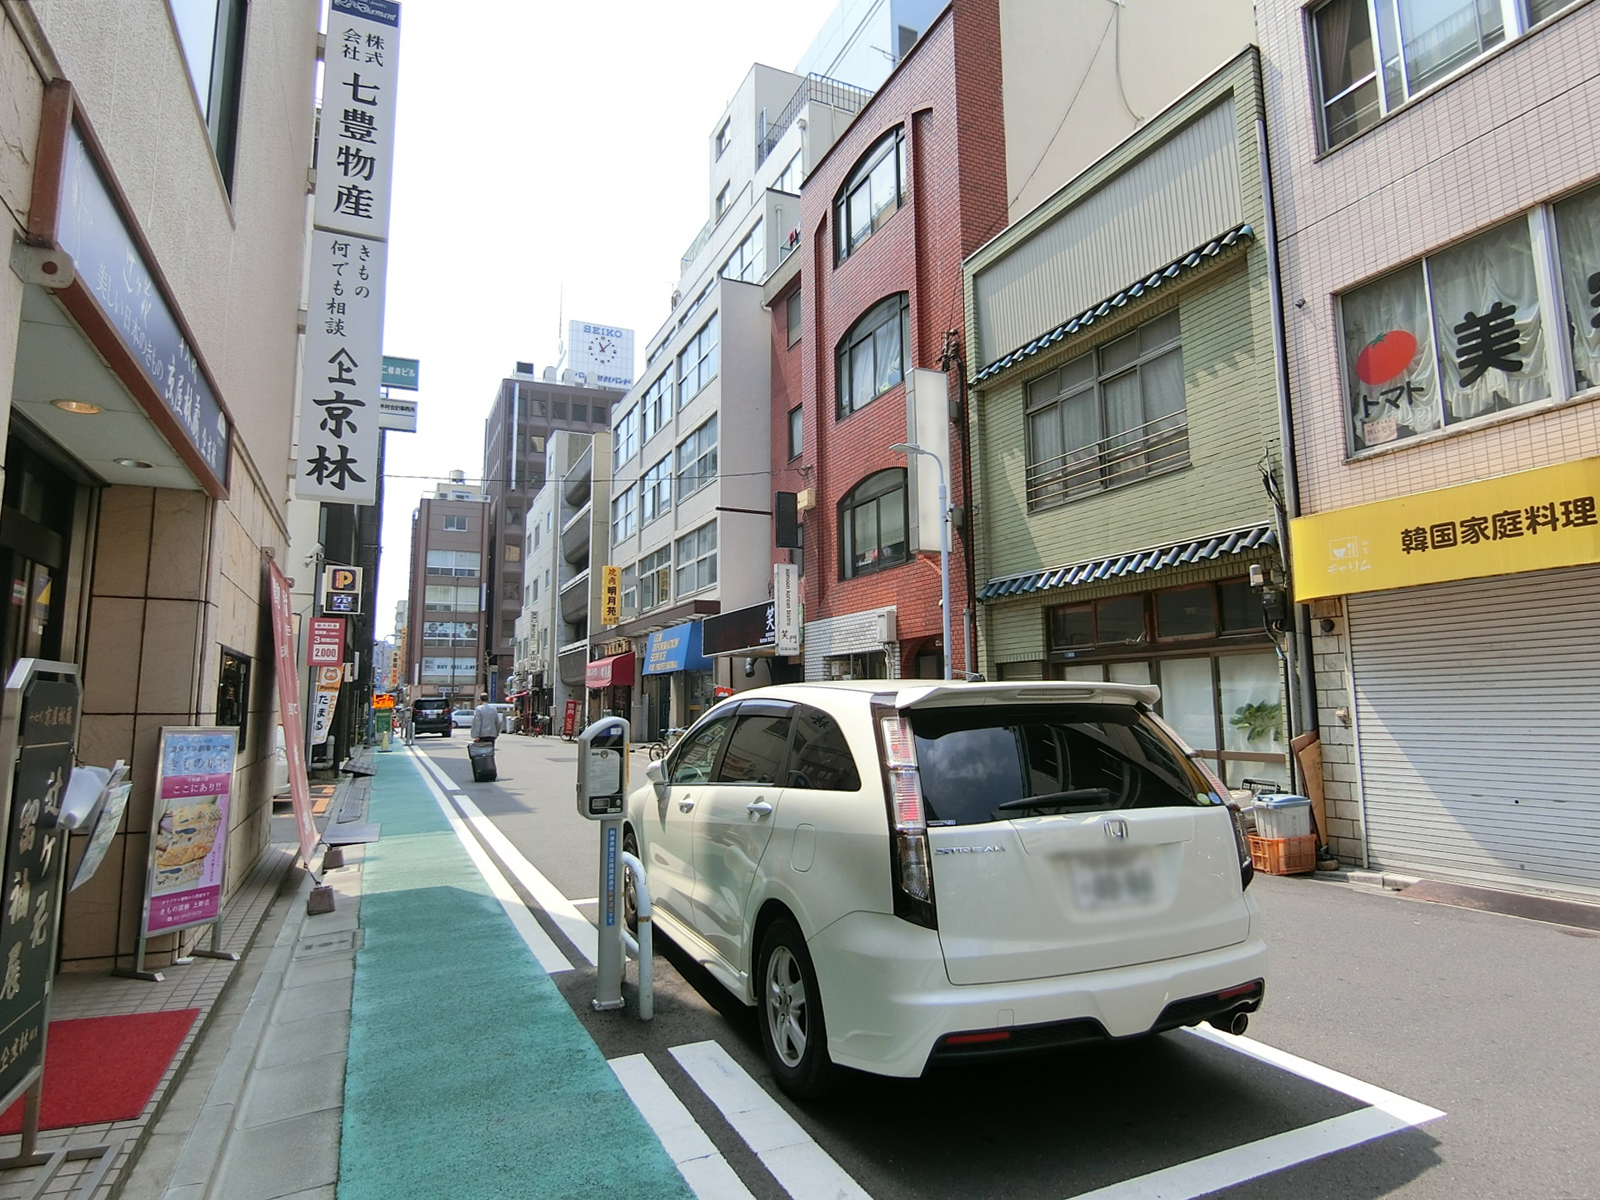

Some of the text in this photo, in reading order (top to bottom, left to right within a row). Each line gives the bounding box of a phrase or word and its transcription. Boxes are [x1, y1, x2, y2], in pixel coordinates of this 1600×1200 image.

[333, 72, 381, 220] 七豊物産
[325, 239, 352, 338] 何でも相談
[354, 244, 371, 299] きもの
[583, 325, 623, 338] SEIKO
[1453, 301, 1523, 389] 美
[1362, 380, 1425, 419] トマト
[1400, 496, 1598, 555] 韓国家庭料理
[332, 594, 352, 611] 空
[607, 586, 617, 617] 明月苑
[314, 695, 329, 731] たまる
[934, 844, 1007, 856] STREAM
